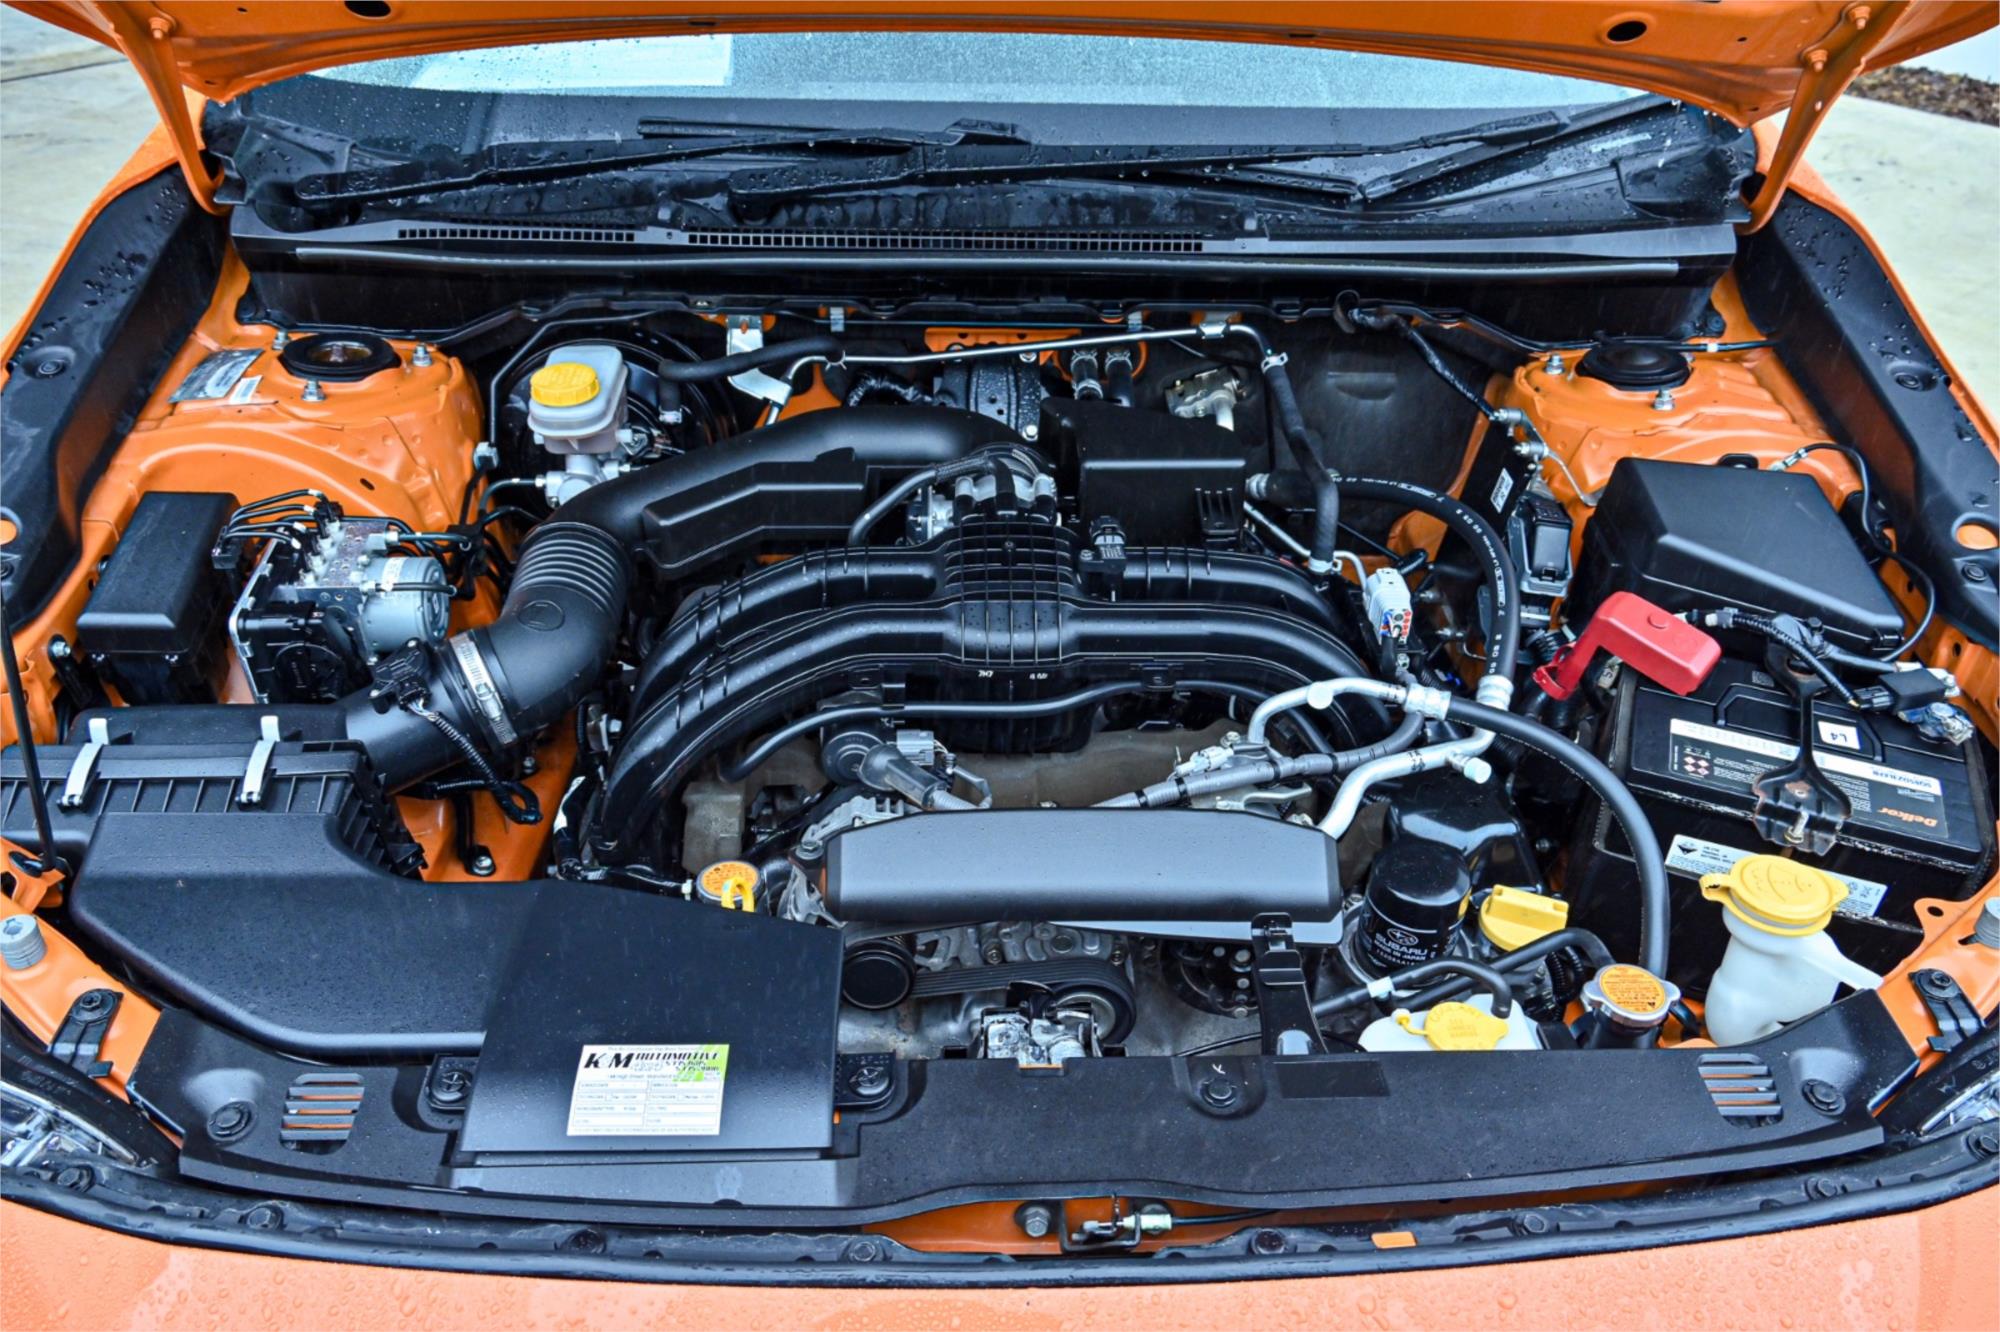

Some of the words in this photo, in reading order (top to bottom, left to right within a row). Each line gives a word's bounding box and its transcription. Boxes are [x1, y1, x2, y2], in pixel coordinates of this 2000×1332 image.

[1829, 731, 1848, 743] L4
[1374, 939, 1392, 953] MADE
[1402, 954, 1427, 962] JAPAN
[1375, 932, 1429, 956] SUBARU
